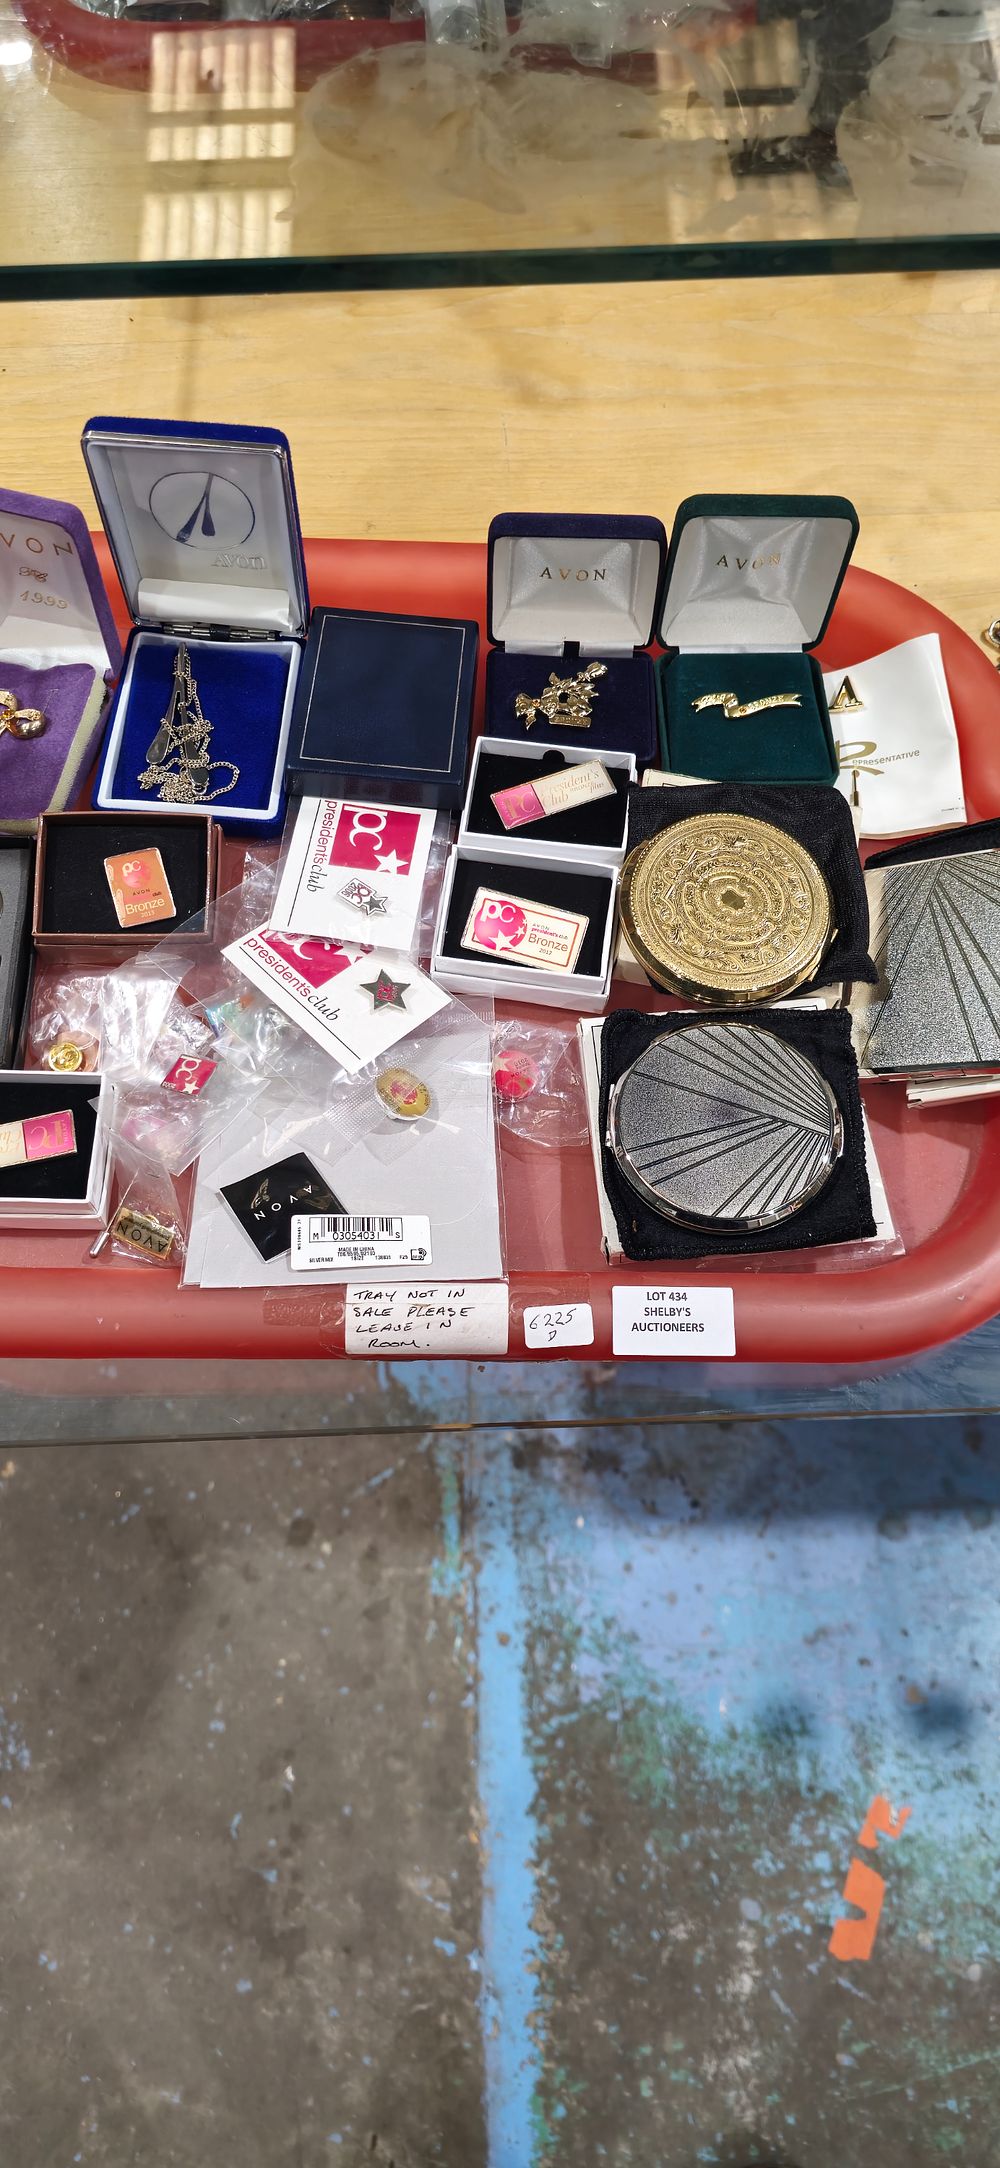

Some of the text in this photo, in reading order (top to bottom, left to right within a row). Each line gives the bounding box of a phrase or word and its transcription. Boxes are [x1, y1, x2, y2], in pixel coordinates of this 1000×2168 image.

[715, 553, 781, 570] AVON
[539, 566, 606, 581] AVON
[306, 864, 327, 892] club
[132, 888, 151, 896] AVON
[125, 898, 165, 915] Bronze
[528, 933, 569, 952] Bronze
[307, 997, 341, 1021] club
[254, 1185, 312, 1220] AVON
[116, 1221, 168, 1252] AVON
[312, 1231, 401, 1240] M 03054031 S
[353, 1288, 465, 1302] TRAY NOT IN
[646, 1291, 688, 1301] LOT 434
[353, 1306, 475, 1317] SALE PLEASE
[529, 1308, 577, 1329] 6225
[644, 1307, 691, 1317] SHELBY'S
[631, 1322, 705, 1332] AUCTIONEERS
[547, 1329, 558, 1342] D
